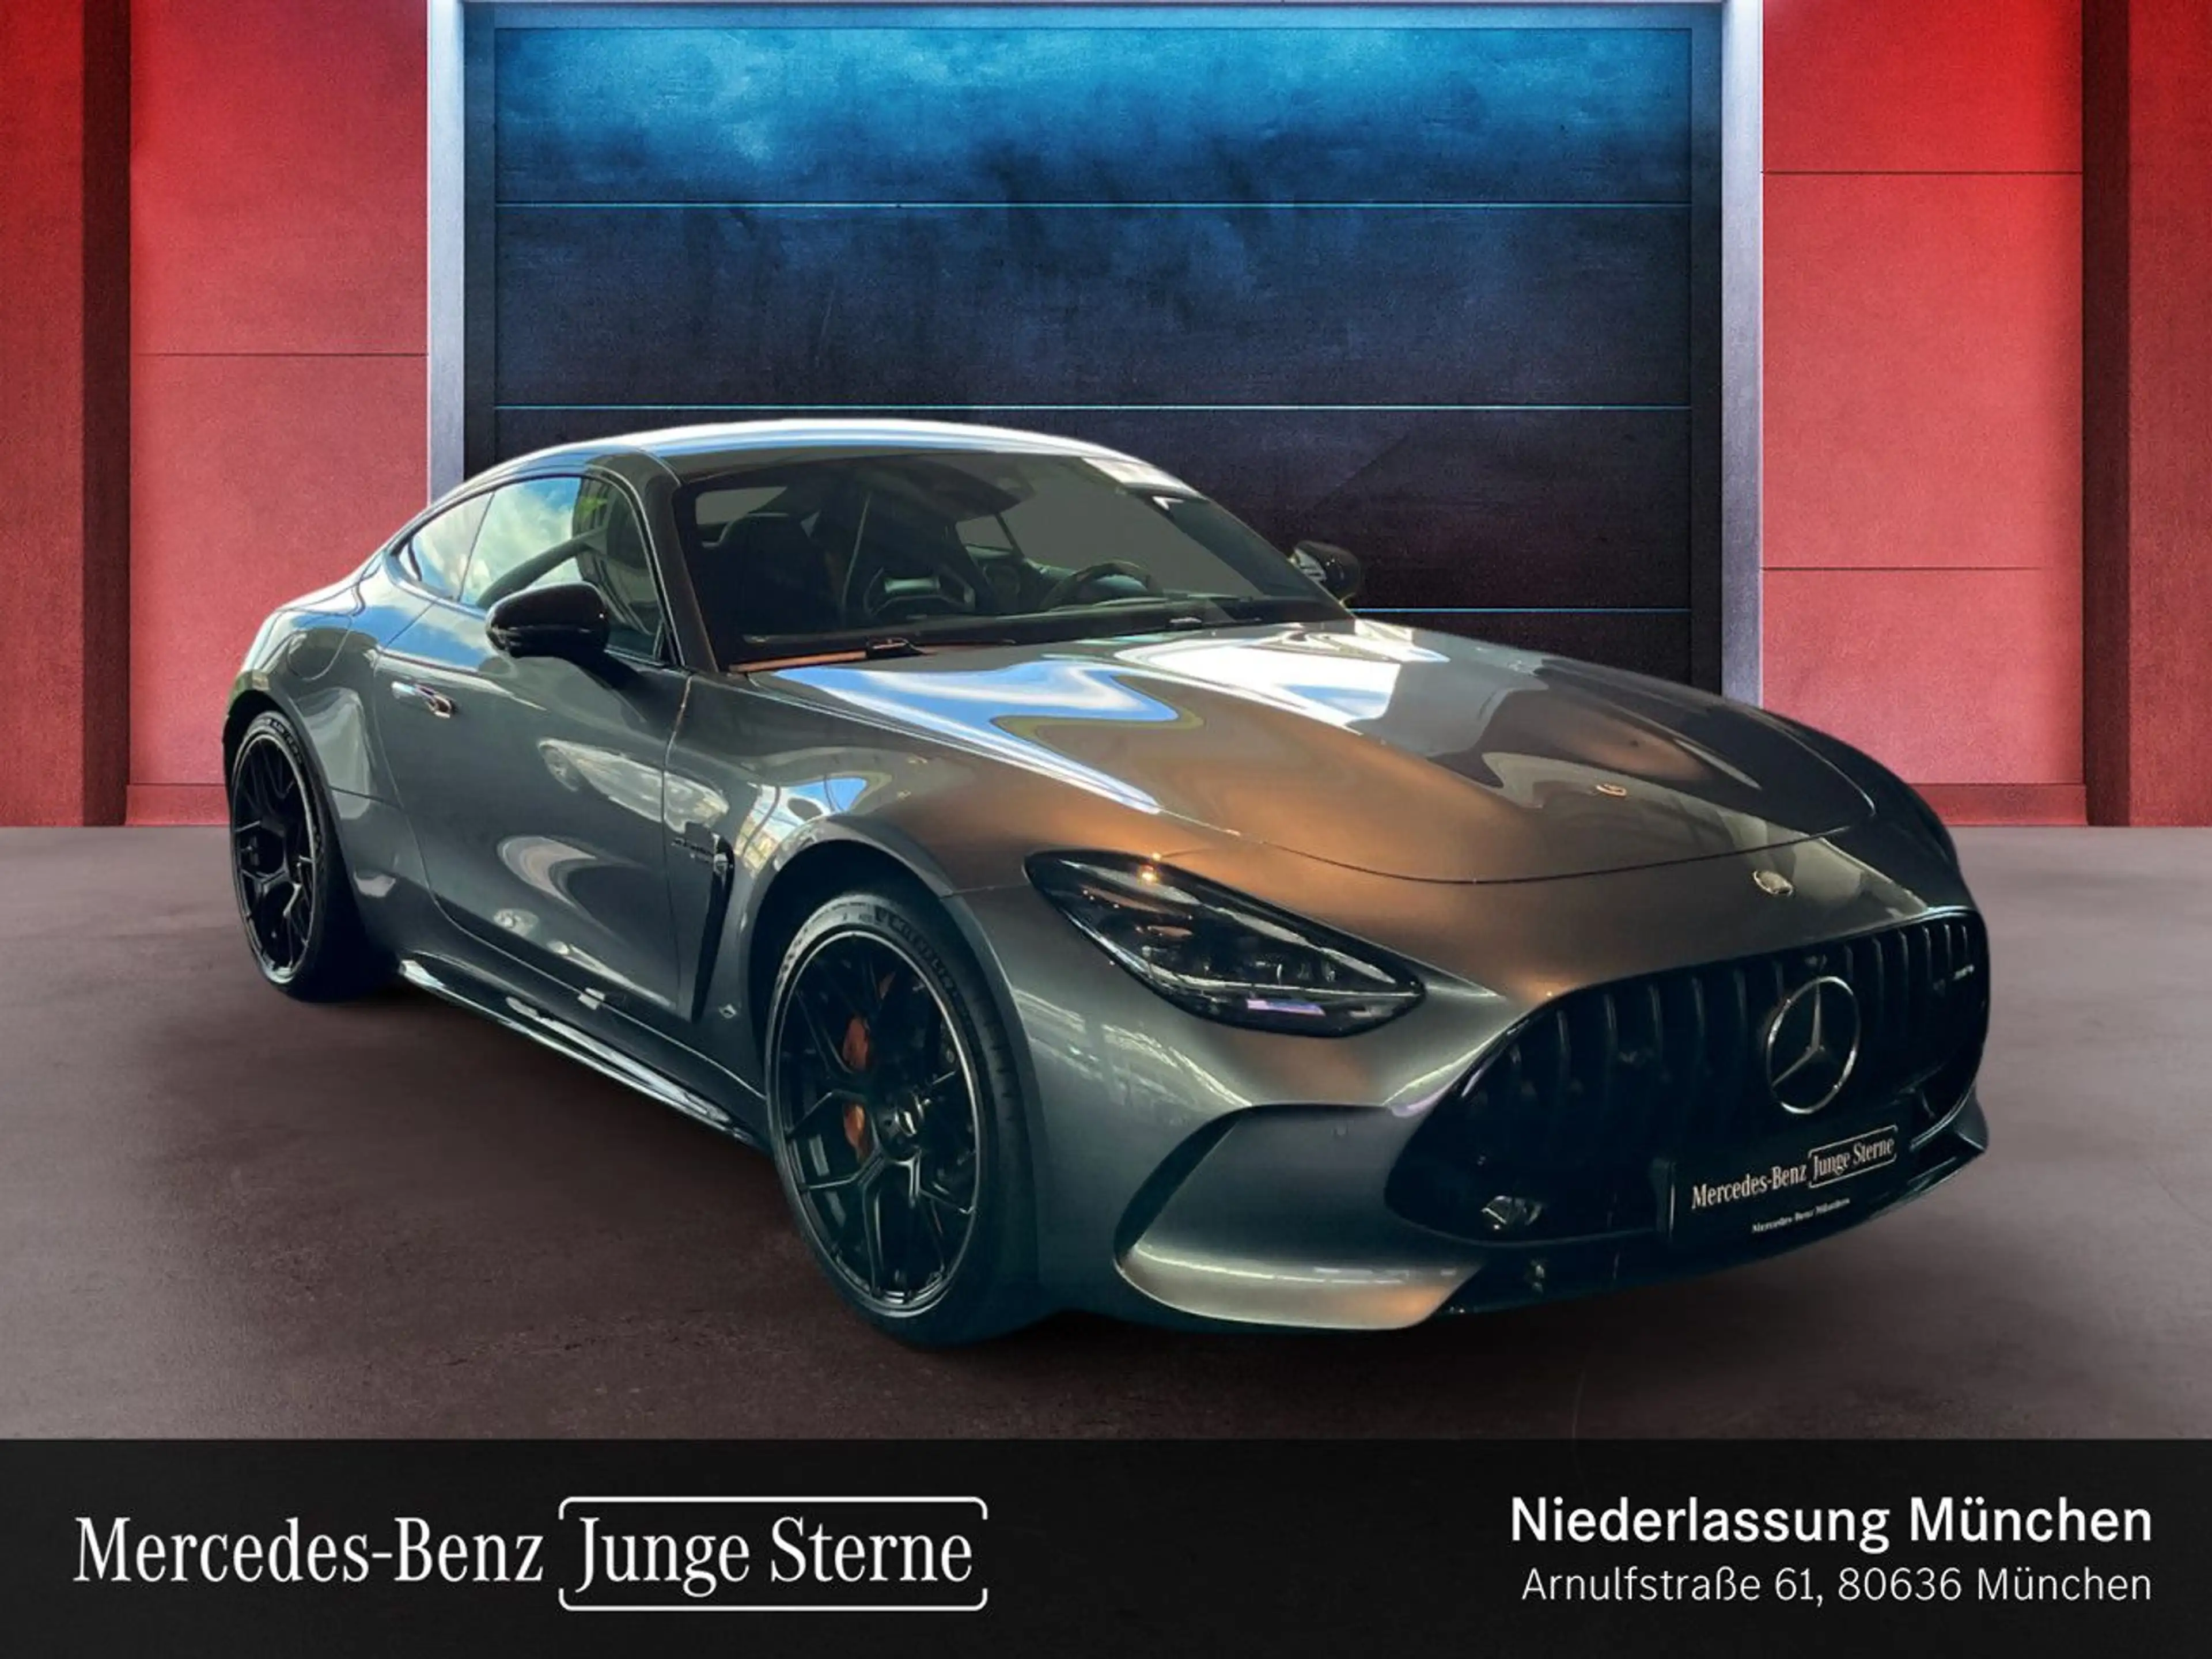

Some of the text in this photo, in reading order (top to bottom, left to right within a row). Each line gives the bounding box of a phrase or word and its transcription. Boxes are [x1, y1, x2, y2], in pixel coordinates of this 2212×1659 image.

[1691, 1138, 1895, 1210] Mercedes-Benz Junge Sterne
